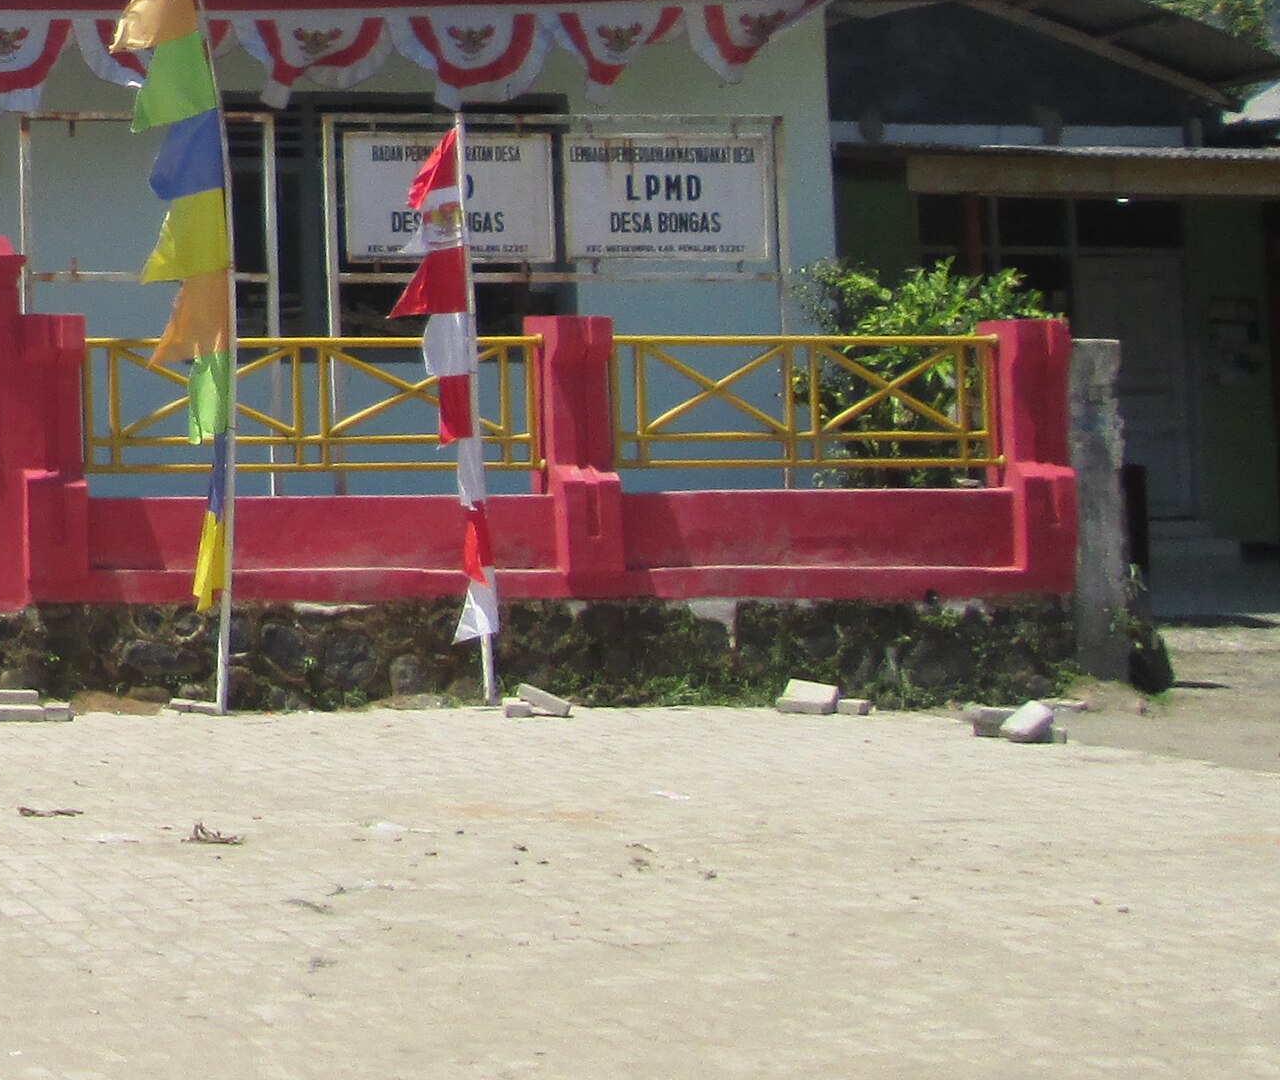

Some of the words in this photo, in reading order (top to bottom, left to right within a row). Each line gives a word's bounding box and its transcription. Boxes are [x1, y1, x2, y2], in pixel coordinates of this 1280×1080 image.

[372, 145, 403, 162] BADAN
[495, 145, 521, 162] DESA
[569, 146, 609, 162] LEMBAGA
[732, 146, 755, 162] DESA
[625, 174, 702, 201] LPMD
[392, 211, 423, 233] DES
[610, 211, 653, 233] DESA
[657, 211, 722, 233] BONGAS
